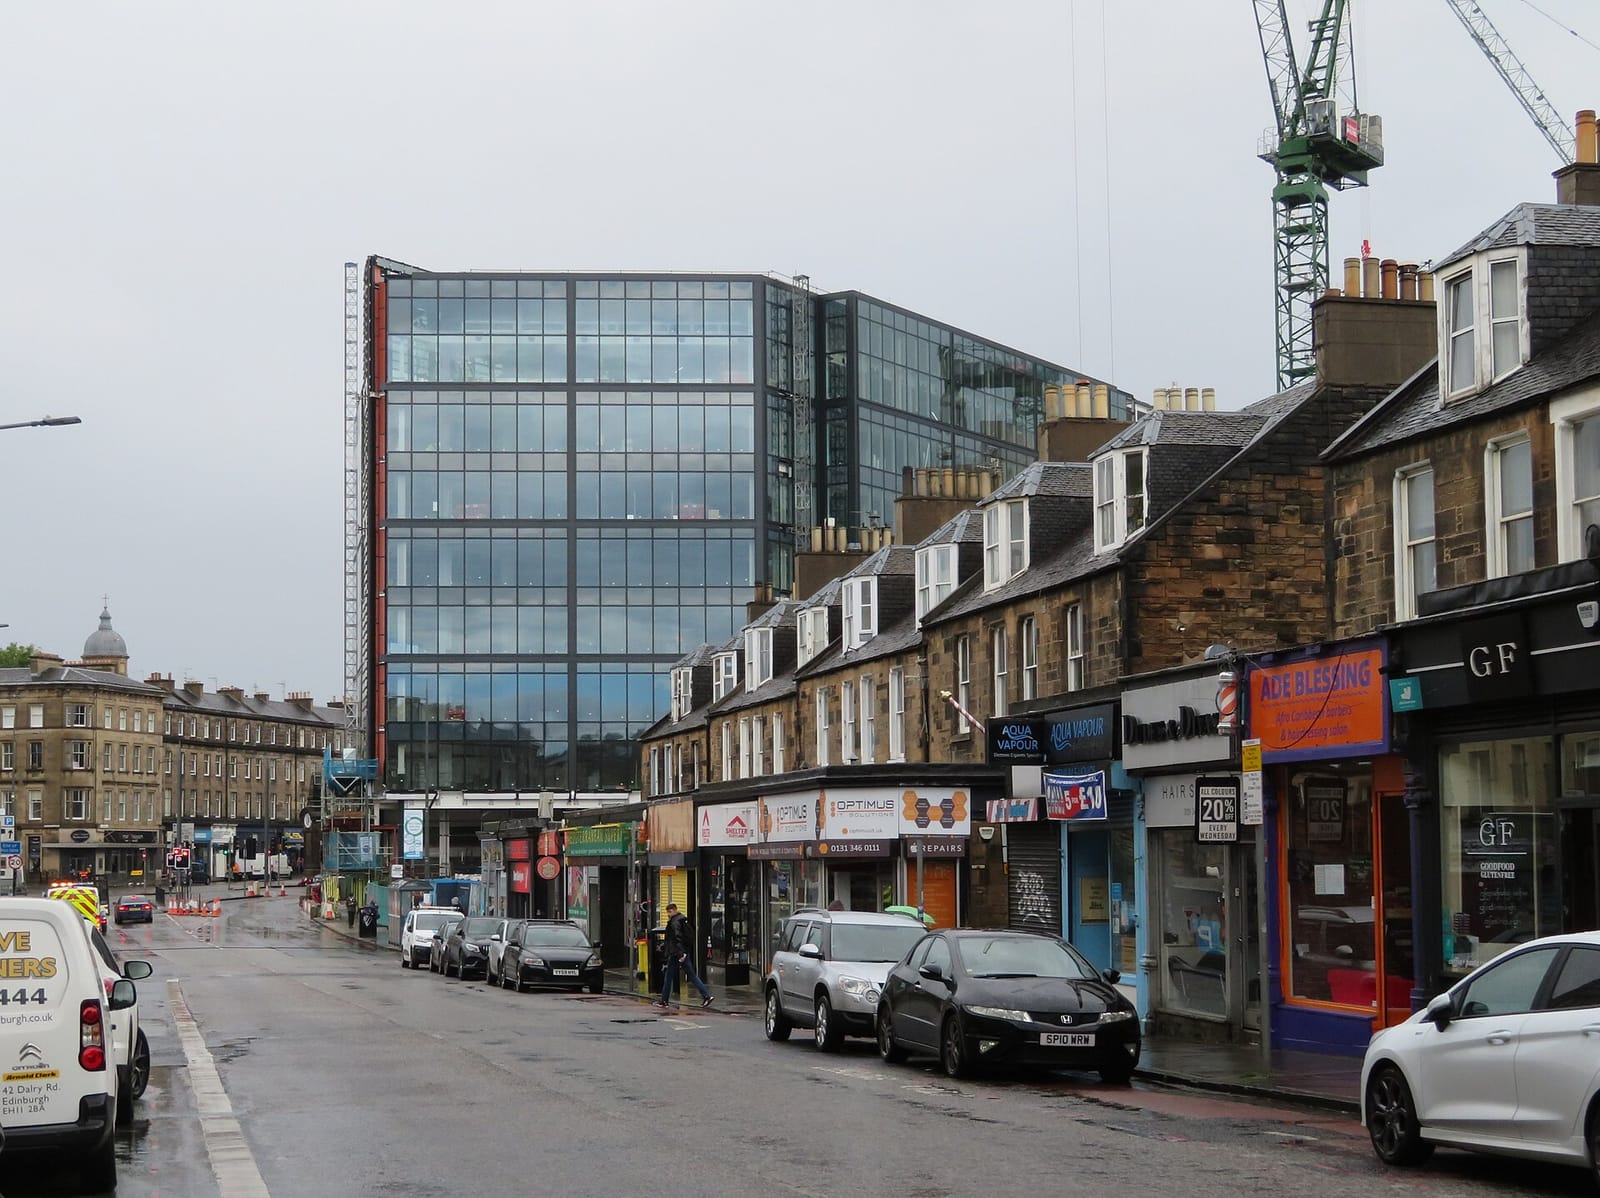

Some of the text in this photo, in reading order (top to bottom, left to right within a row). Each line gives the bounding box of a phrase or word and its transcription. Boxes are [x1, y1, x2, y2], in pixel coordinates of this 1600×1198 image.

[1470, 642, 1518, 677] GF
[1261, 660, 1371, 700] ADE BLESSING
[1276, 711, 1290, 726] Afro
[1326, 705, 1352, 717] barbers
[1002, 725, 1032, 738] AQUA
[1050, 722, 1072, 746] AQUA
[1073, 717, 1104, 739] VAPOUR
[997, 740, 1038, 750] VAPOUR
[1162, 784, 1186, 799] HAIR
[1200, 787, 1236, 796] ALL COLOURS
[1064, 790, 1072, 810] 5
[1079, 785, 1102, 810] £10
[837, 800, 894, 810] OPTIMUS
[1209, 824, 1227, 832] EVERY
[1200, 832, 1236, 840] WEDNESDAY
[1479, 822, 1515, 846] GF
[831, 844, 880, 852] 0131 346 0111
[1046, 1034, 1069, 1045] SP10
[6, 1073, 34, 1081] Arnold
[2, 1086, 14, 1095] 42
[17, 1084, 43, 1095] Dalry
[2, 1094, 49, 1106] Edinburgh
[28, 1104, 45, 1113] 2BA
